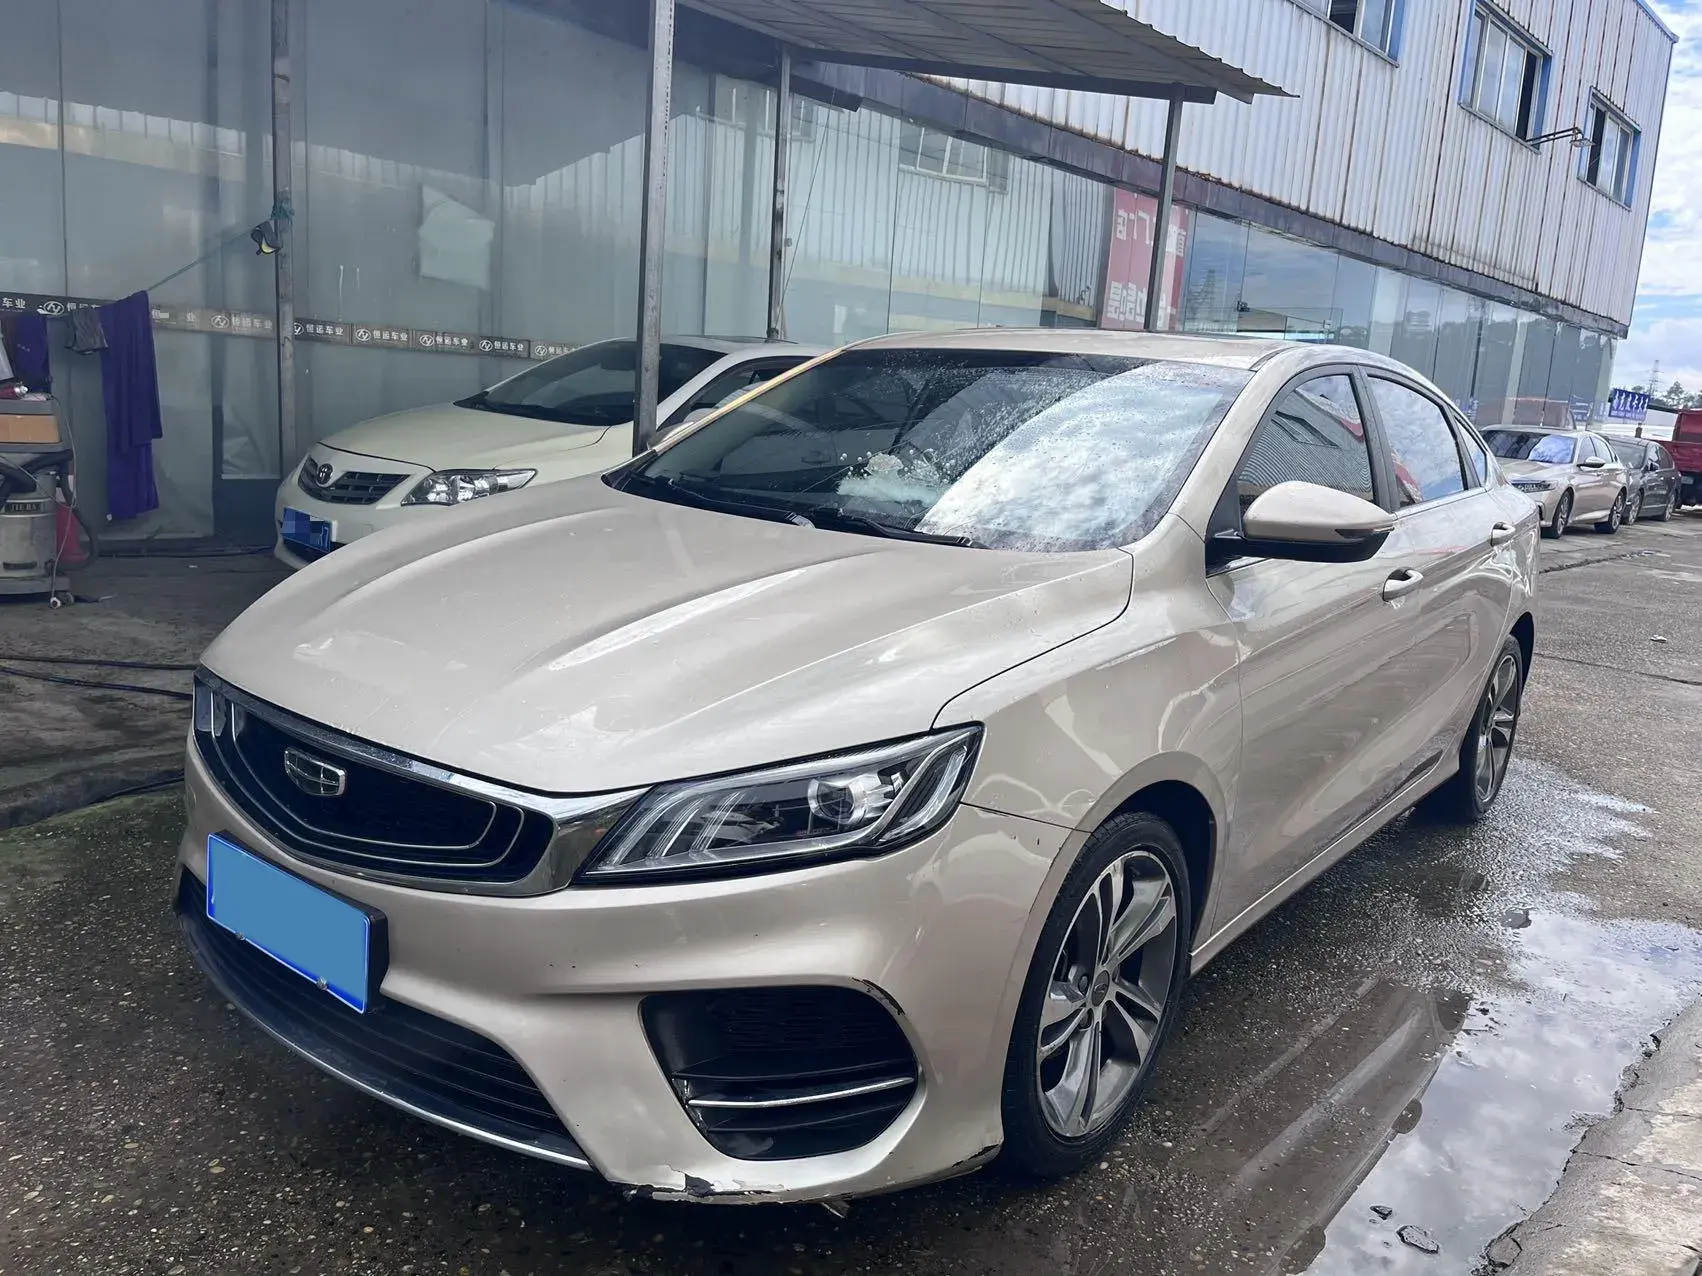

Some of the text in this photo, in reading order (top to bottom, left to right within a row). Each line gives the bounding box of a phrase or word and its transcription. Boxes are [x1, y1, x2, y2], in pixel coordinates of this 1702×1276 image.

[306, 323, 344, 336] 恒运车业
[373, 330, 408, 341] 恒运车业
[436, 335, 468, 346] 恒运车业
[494, 340, 524, 351] 恒运车业
